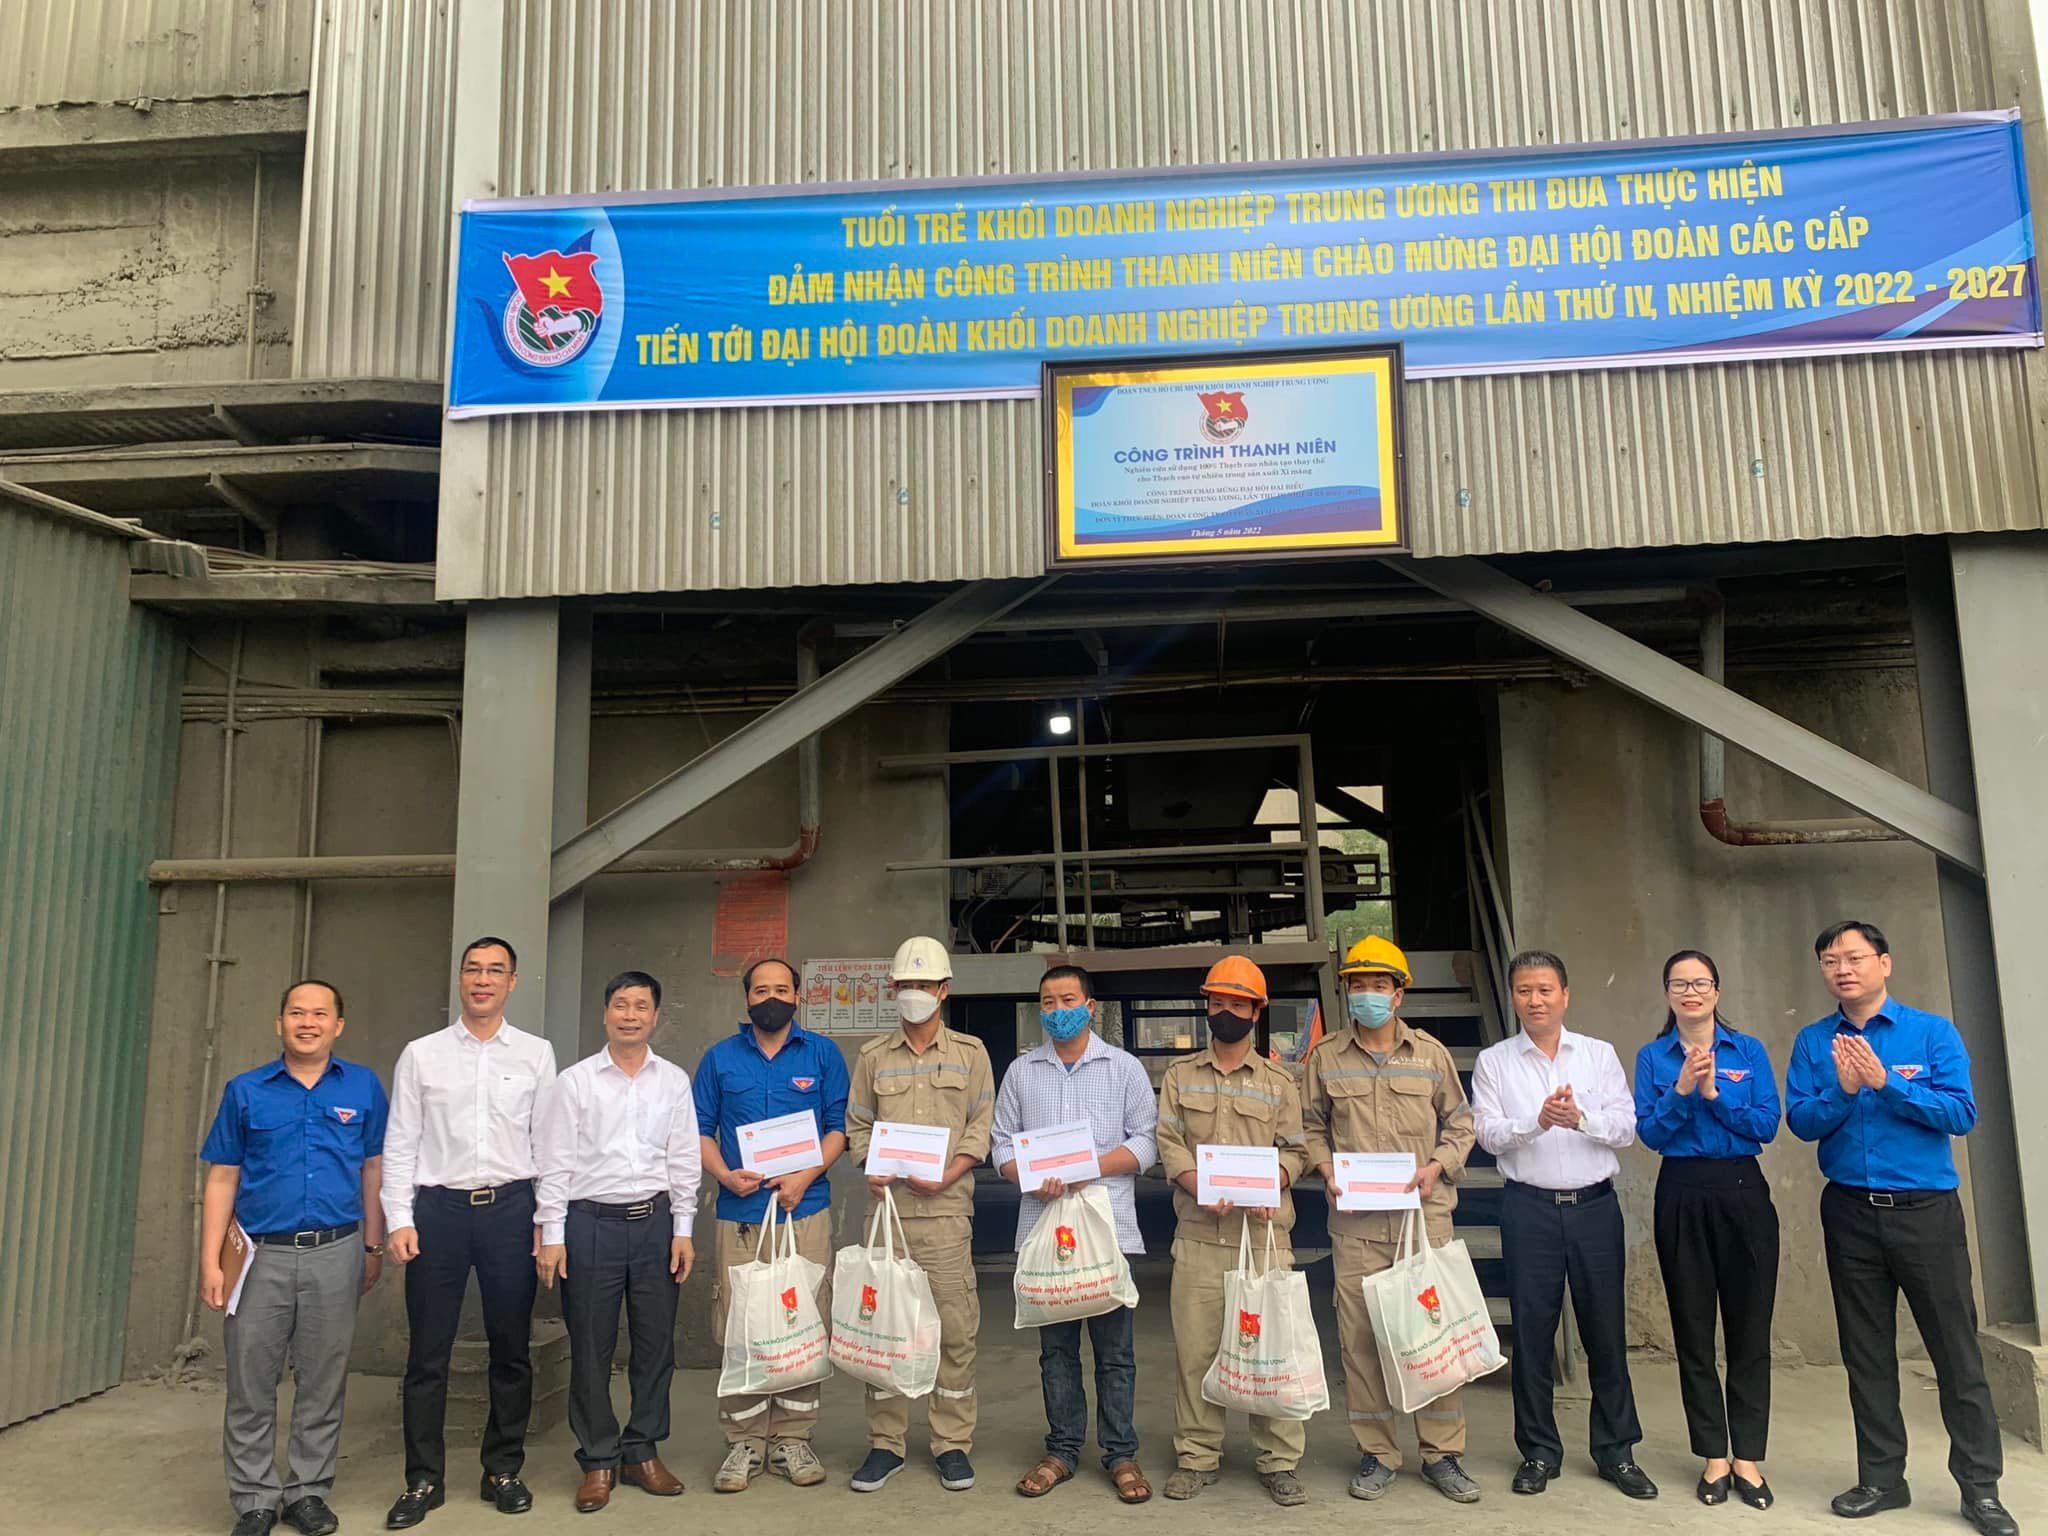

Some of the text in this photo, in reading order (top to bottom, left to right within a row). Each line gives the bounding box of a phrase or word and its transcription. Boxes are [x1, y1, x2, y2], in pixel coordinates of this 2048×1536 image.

[841, 159, 1783, 248] TUỔI TRẺ KHỐI DOANH NGHIỆP TRUNG ƯƠNG THI ĐUA THỰC HIỆN
[768, 206, 1869, 306] ĐẢM NHẬN CÔNG TRÌNH THANH NIÊN CHÀO MỪNG ĐẠI HỘI ĐOÀN CÁC CẤP
[636, 323, 699, 365] TIẾN
[708, 324, 753, 362] TỚI
[762, 327, 810, 367] ĐẠI
[820, 319, 868, 364] HỘI
[877, 318, 958, 355] ĐOÀN
[967, 305, 1036, 352] KHỐI
[1046, 311, 1148, 348] DOANH
[1157, 299, 1269, 345] NGHIỆP
[1278, 299, 1380, 336] TRUNG
[1389, 293, 1475, 330] ƯƠNG
[1485, 281, 1545, 325] LẦN
[1554, 279, 1617, 321] THỨ
[1667, 273, 1773, 319] NHIỆM
[1783, 269, 1823, 309] KỲ
[1835, 271, 1916, 306] 2022
[1948, 263, 2027, 301] 2027
[1114, 437, 1336, 464] CÔNG TRÌNH THANH NIÊN
[1242, 526, 1262, 535] 2022
